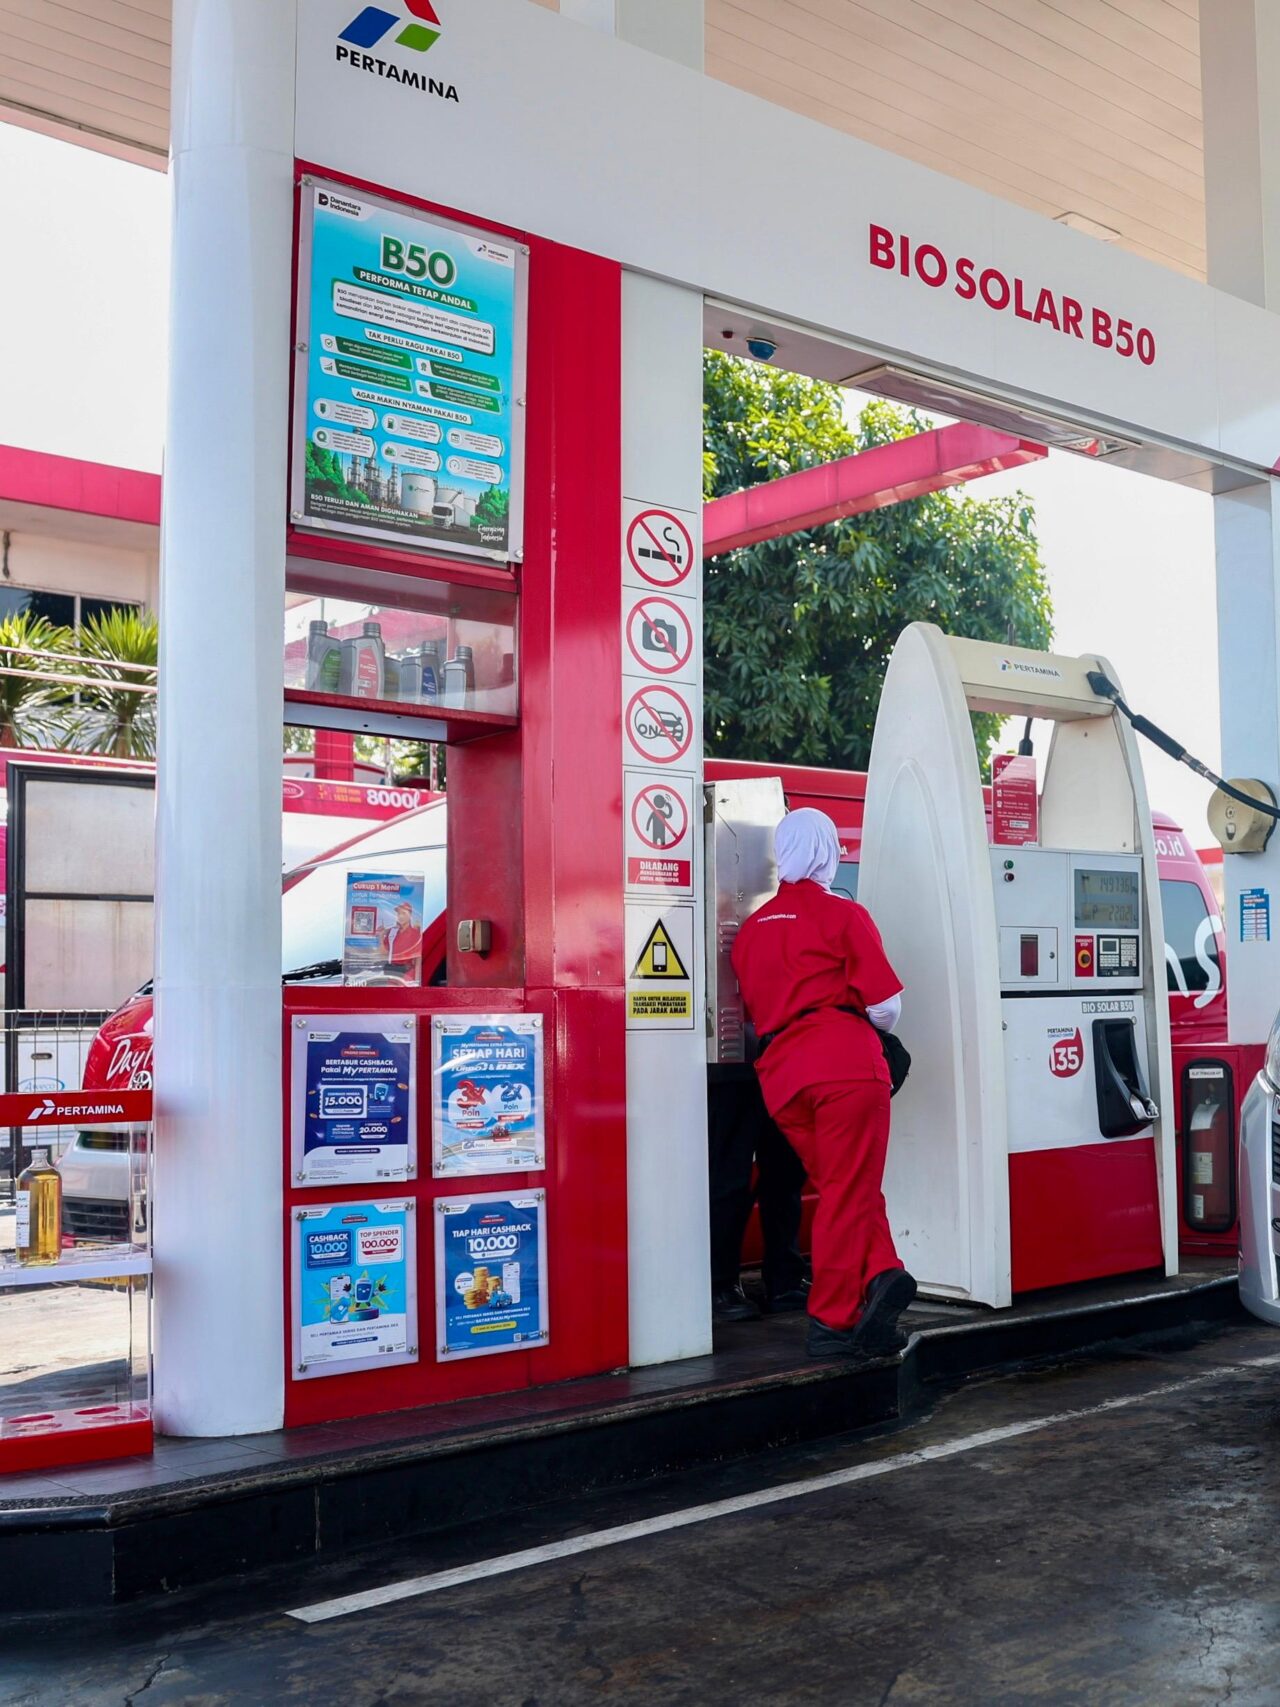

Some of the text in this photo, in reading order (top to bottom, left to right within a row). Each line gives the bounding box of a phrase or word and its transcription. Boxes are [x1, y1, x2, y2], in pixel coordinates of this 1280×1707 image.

[336, 45, 459, 103] PERTAMINA
[330, 203, 359, 216] Indonesia
[331, 196, 361, 210] Danantara
[381, 234, 456, 287] B50
[360, 270, 472, 310] PERFORMA TETAP ANDAL
[869, 223, 1156, 366] BIO SOLAR B50
[368, 331, 460, 360] TAK PERLU RAGU PAKAI B50
[356, 391, 468, 422] AGAR MAKIN NYAMAN PAKAI B50
[324, 496, 344, 505] TERUJI
[360, 504, 380, 512] AMAN
[380, 507, 418, 518] DIGUNAKAN
[1014, 664, 1061, 677] PERTAMINA
[637, 724, 658, 736] ON
[640, 861, 680, 872] DILARANG
[1082, 1001, 1133, 1012] BIO SOLAR B50
[453, 1048, 524, 1059] SETIAP HARI
[1050, 1046, 1080, 1072] 135
[342, 1066, 398, 1076] MyPERTAMINA
[325, 1096, 362, 1106] 15.000
[56, 1104, 124, 1116] PERTAMINA
[452, 1224, 531, 1238] TIAP HARI CASHBACK
[309, 1233, 348, 1243] CASHBACK
[361, 1238, 398, 1248] 100.000
[468, 1235, 517, 1252] 10.000
[311, 1241, 347, 1253] 10.000
